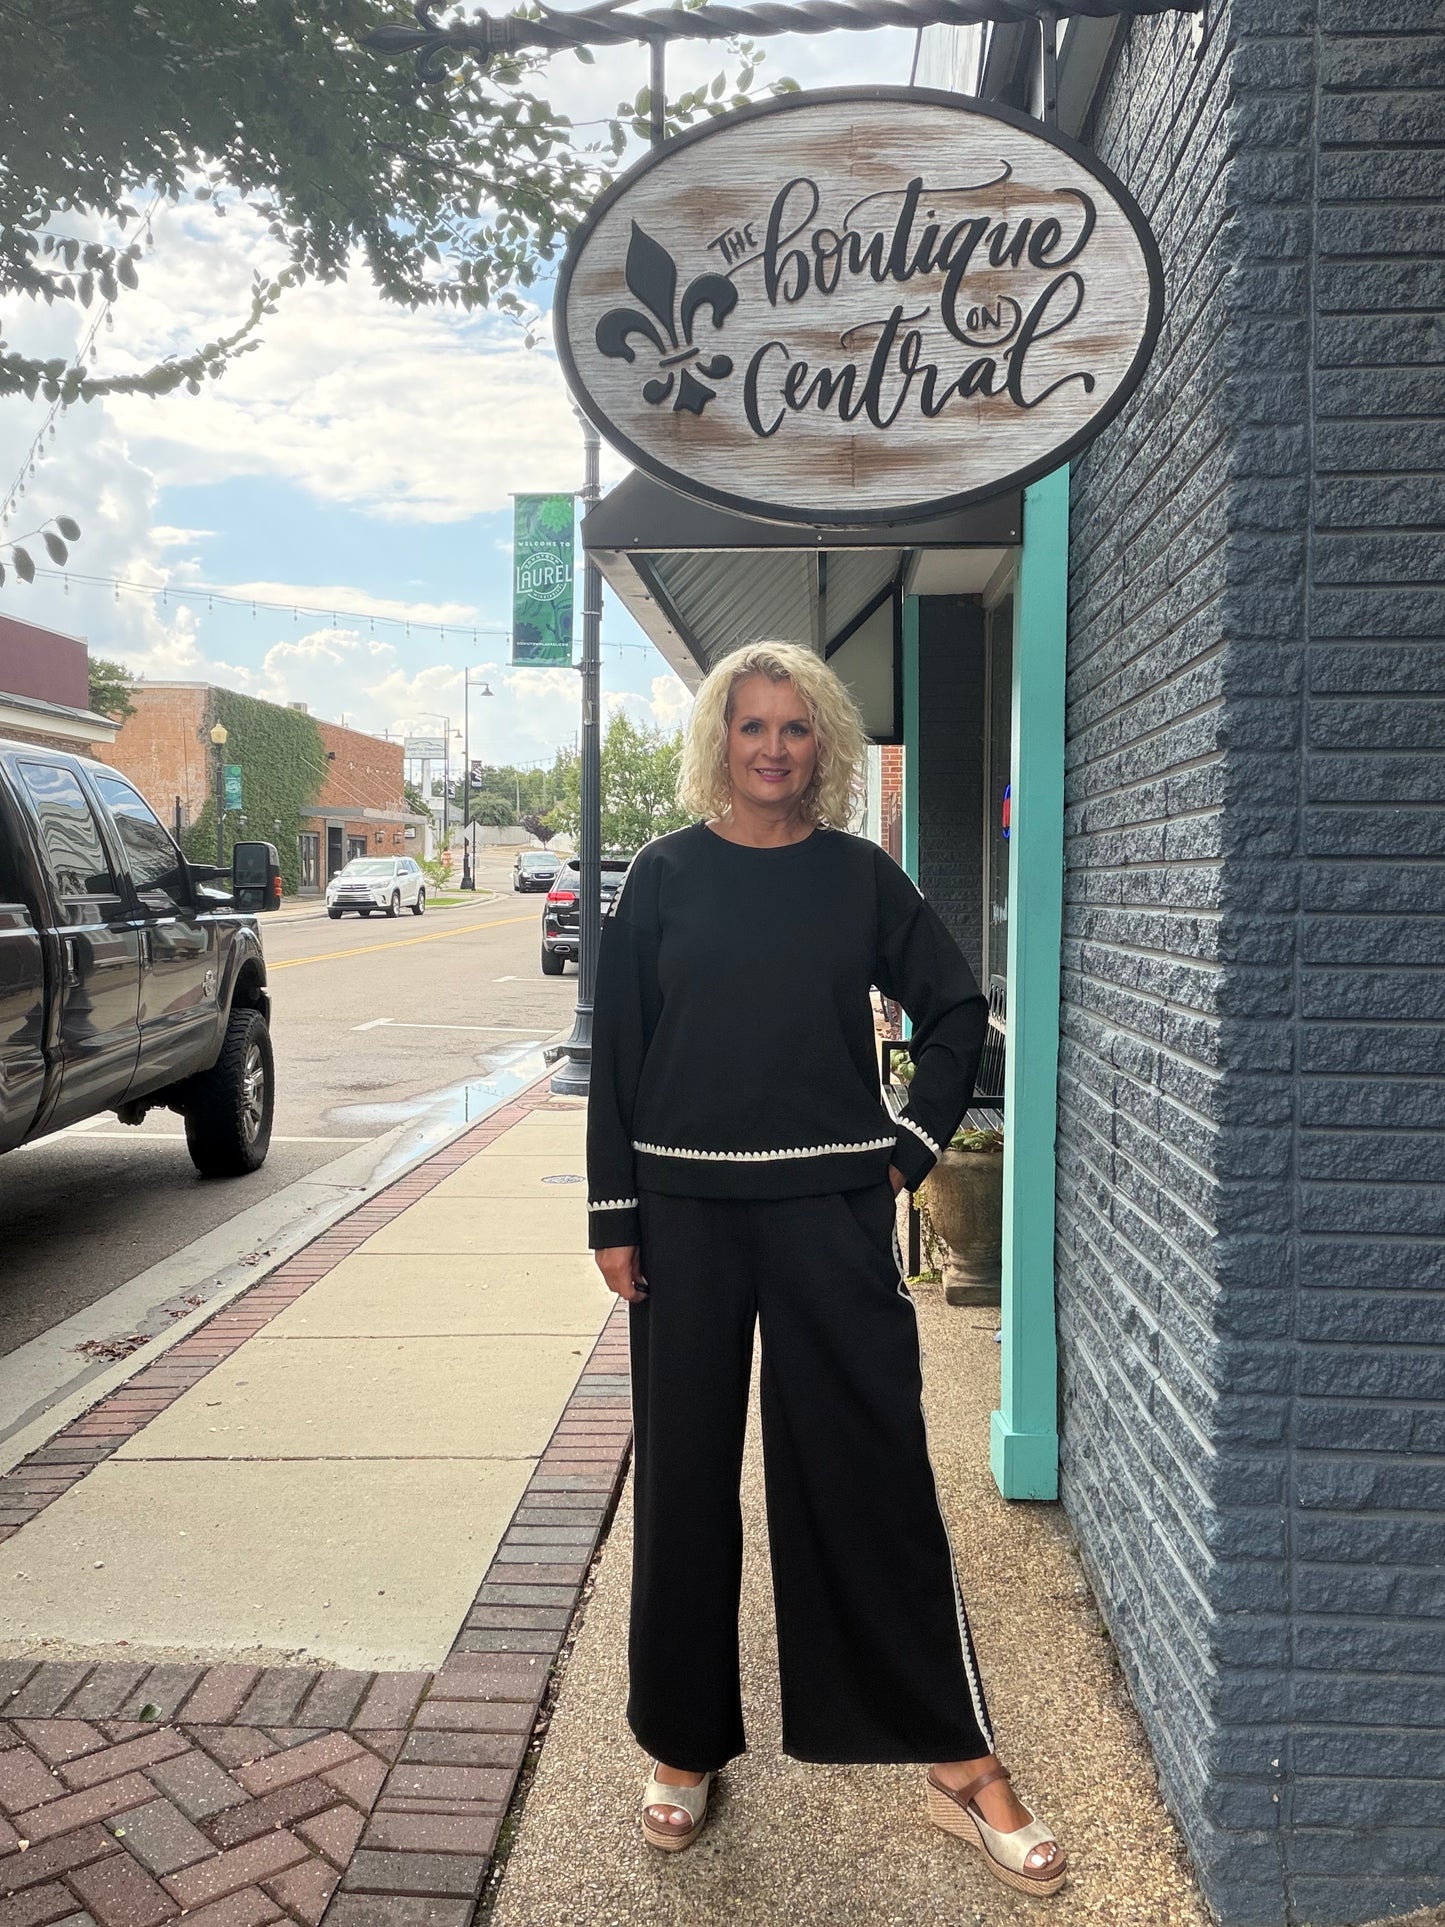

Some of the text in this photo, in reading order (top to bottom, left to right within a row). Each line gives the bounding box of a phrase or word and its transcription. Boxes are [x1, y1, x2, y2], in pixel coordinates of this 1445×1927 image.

[707, 160, 1097, 347] THE boutique
[966, 305, 1001, 331] ON
[743, 271, 1095, 437] Central
[525, 554, 560, 569] DOWNTOWN
[516, 564, 572, 594] LAUREL
